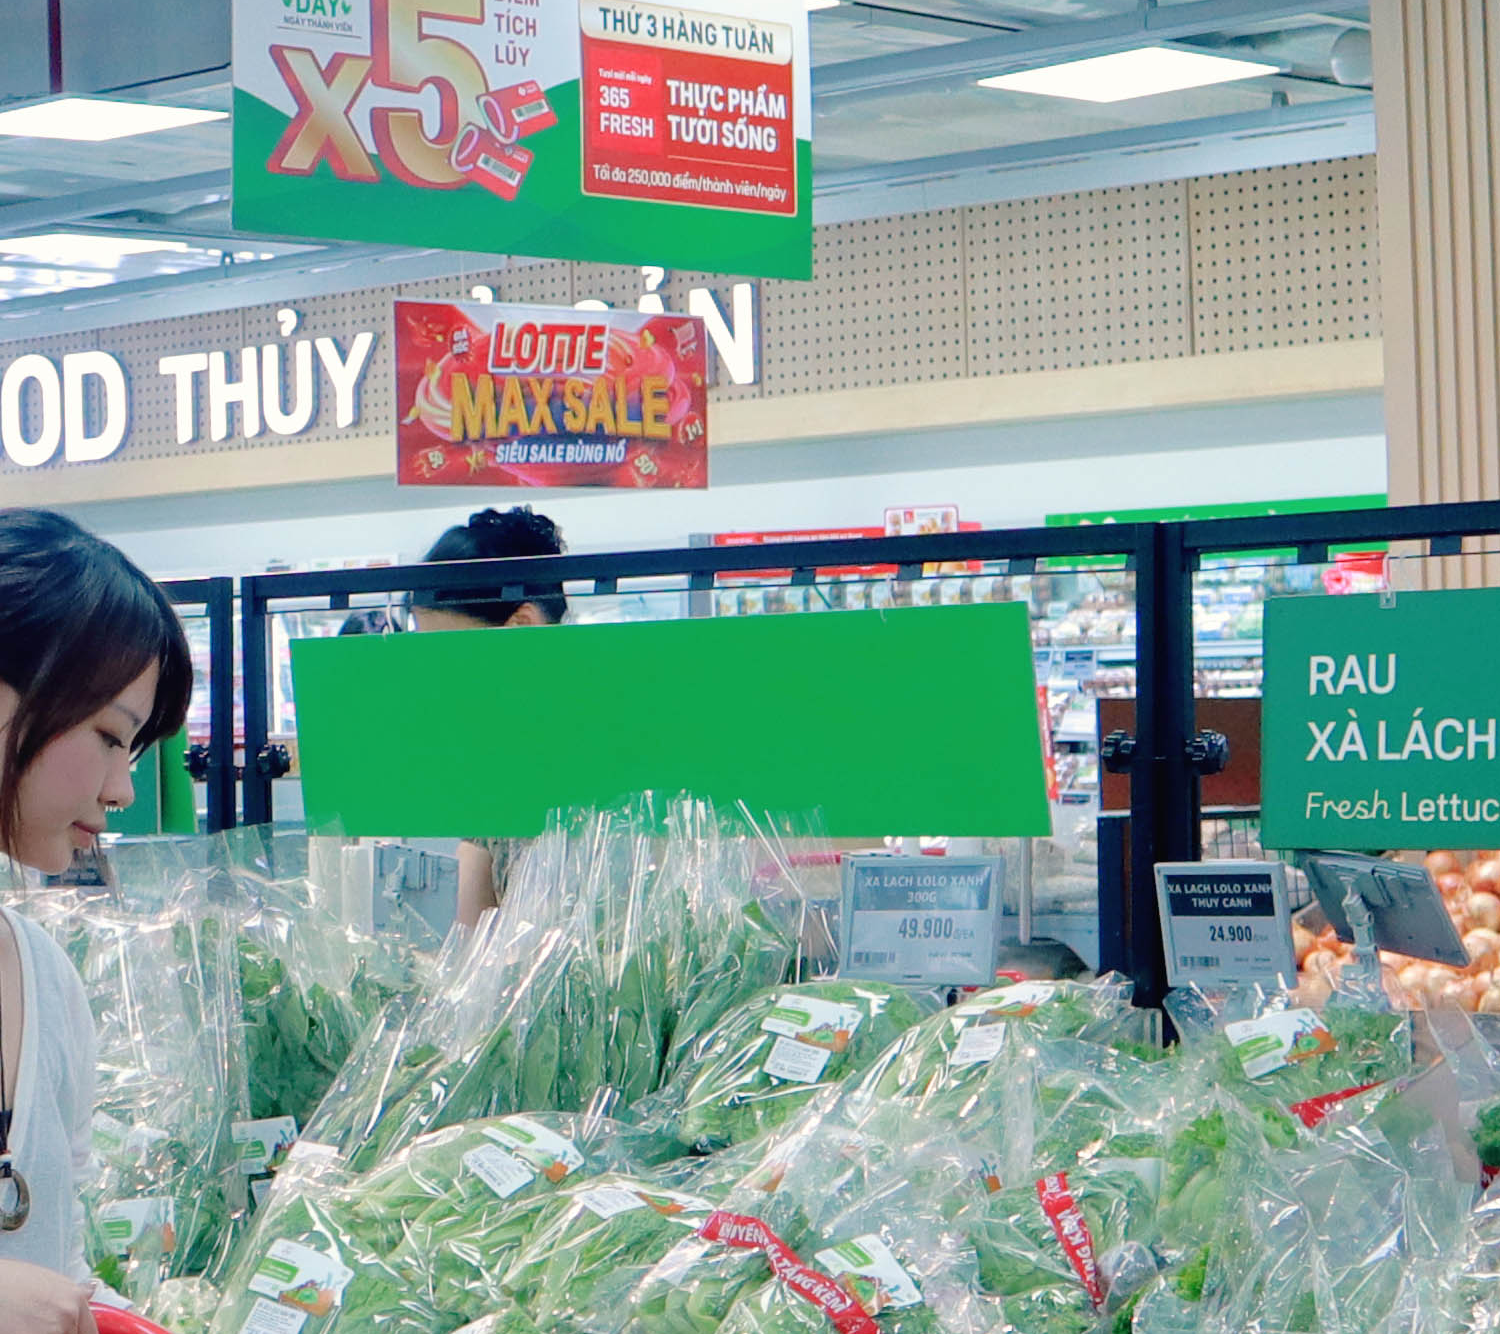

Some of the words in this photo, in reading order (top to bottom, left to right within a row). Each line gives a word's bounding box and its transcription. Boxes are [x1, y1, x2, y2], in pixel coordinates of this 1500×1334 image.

[494, 9, 537, 36] TÍCH
[600, 5, 642, 34] THỨ
[647, 15, 656, 37] 3
[664, 12, 717, 45] HÀNG
[721, 23, 774, 54] TUẦN
[495, 41, 530, 67] LŨY
[600, 86, 630, 108] 365
[667, 80, 724, 116] THỰC
[728, 85, 786, 119] PHẨM
[600, 113, 654, 137] FRESH
[668, 115, 717, 146] TƯƠI
[722, 117, 777, 152] SỐNG
[593, 163, 609, 180] Tối
[612, 168, 626, 182] đa
[628, 169, 671, 188] 250,000
[488, 320, 610, 374] LOTTE
[159, 307, 375, 445] THỦY
[450, 373, 557, 441] MAX
[563, 376, 671, 439] SALE
[1309, 654, 1396, 696] RAU
[1306, 713, 1364, 761] XÀ
[1379, 707, 1497, 761] LÁCH
[1305, 790, 1391, 820] Fresh
[1168, 884, 1181, 893] XA
[1184, 884, 1210, 893] LACH
[1214, 884, 1241, 893] LOLO
[1244, 884, 1272, 893] XANH
[1192, 898, 1219, 907] THUY
[1223, 898, 1252, 907] CANH
[1210, 926, 1252, 941] 24.900
